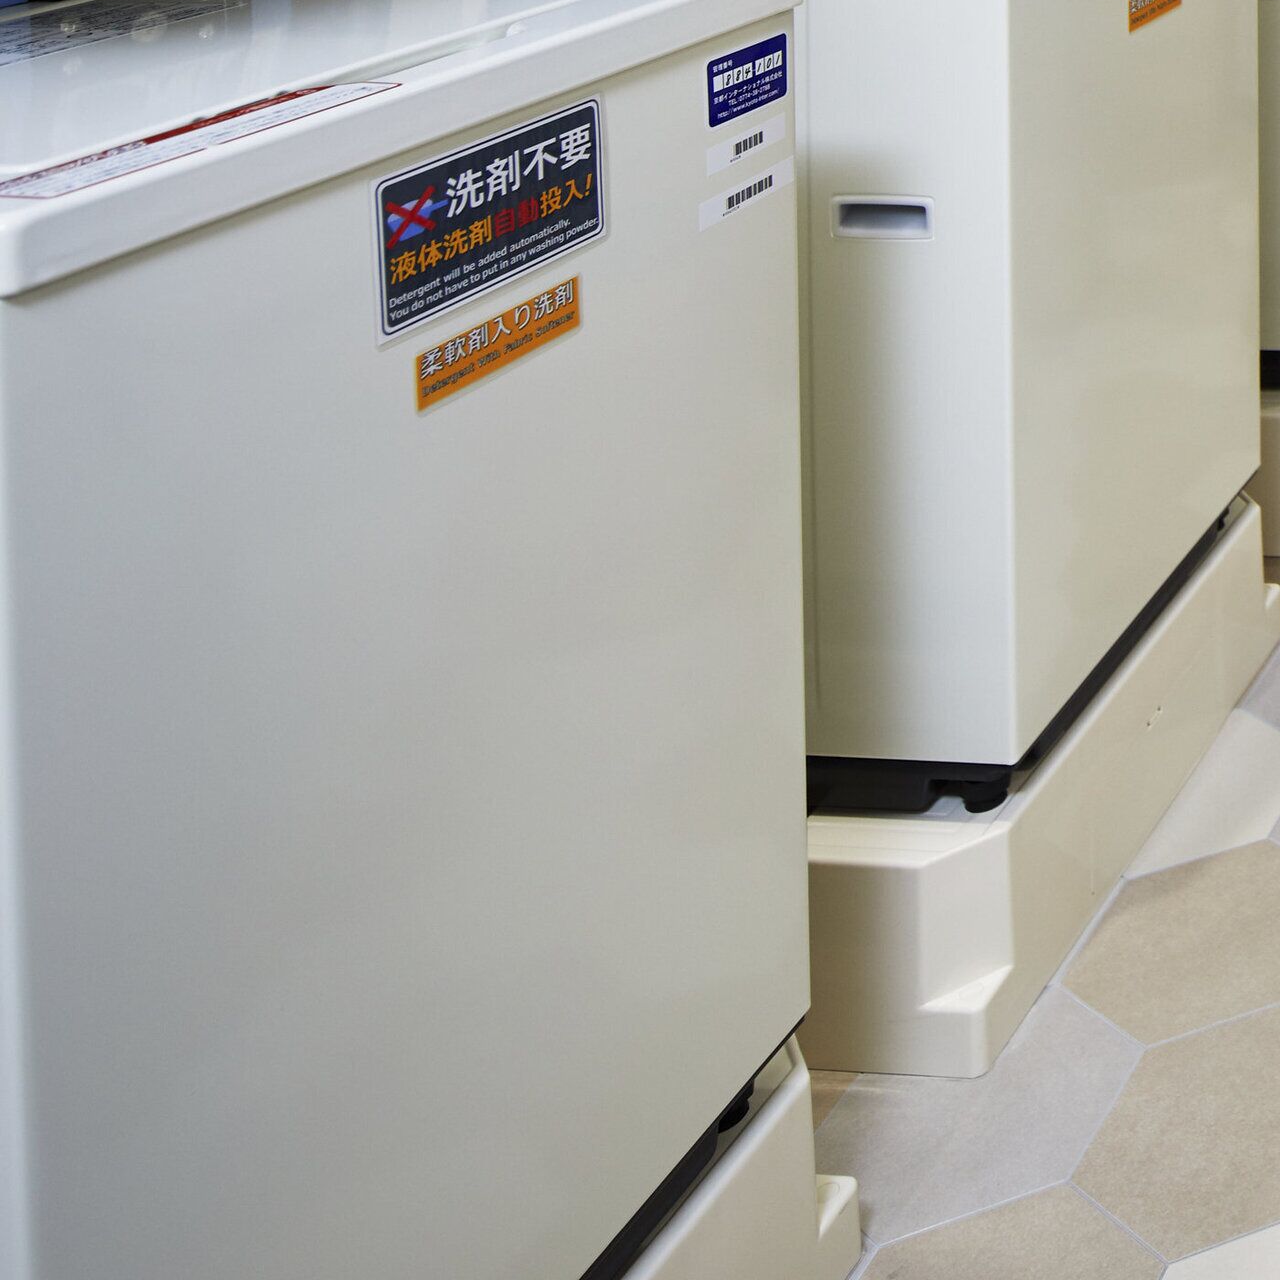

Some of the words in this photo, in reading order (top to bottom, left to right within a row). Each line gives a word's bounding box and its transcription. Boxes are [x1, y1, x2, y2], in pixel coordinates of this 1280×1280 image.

[446, 122, 592, 219] 洗剤不要
[388, 276, 441, 309] Detergent
[444, 267, 461, 283] will
[463, 261, 476, 273] be
[478, 247, 507, 267] added
[509, 218, 571, 252] automatically.
[389, 304, 410, 322] You
[411, 299, 425, 312] do
[426, 291, 444, 307] not
[444, 280, 469, 297] have
[470, 273, 481, 285] to
[482, 264, 499, 282] put
[500, 258, 509, 271] in
[510, 249, 528, 267] any
[529, 232, 565, 257] washing
[566, 216, 600, 243] powder.
[390, 173, 593, 286] 液体洗剤自動投入!
[420, 280, 574, 381] 柔軟剤入り洗剤
[422, 362, 475, 398] Detergent
